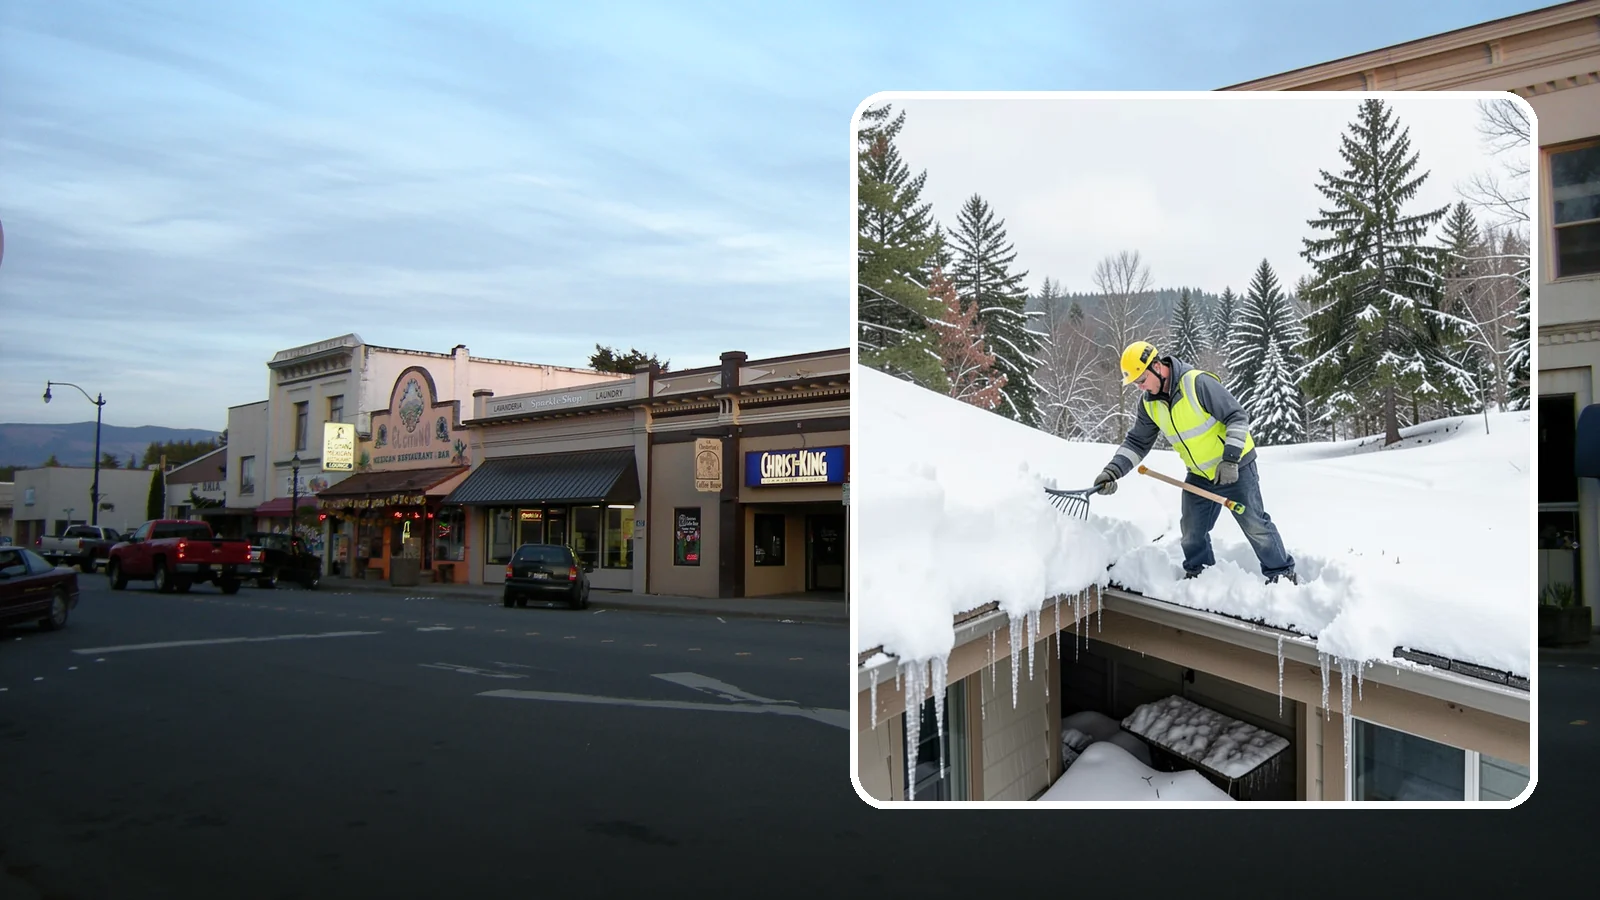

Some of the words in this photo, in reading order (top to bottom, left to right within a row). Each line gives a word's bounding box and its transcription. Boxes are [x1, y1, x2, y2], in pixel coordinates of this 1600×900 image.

[494, 402, 522, 412] LAVANDERIA
[531, 397, 560, 409] Sparkle
[563, 395, 582, 406] Shop
[595, 389, 623, 399] LAUNDRY
[373, 454, 396, 464] MEXICAN
[397, 451, 433, 462] RESTAURANT
[438, 450, 449, 459] BAR
[761, 452, 797, 478] CHRIST
[799, 450, 827, 476] KING
